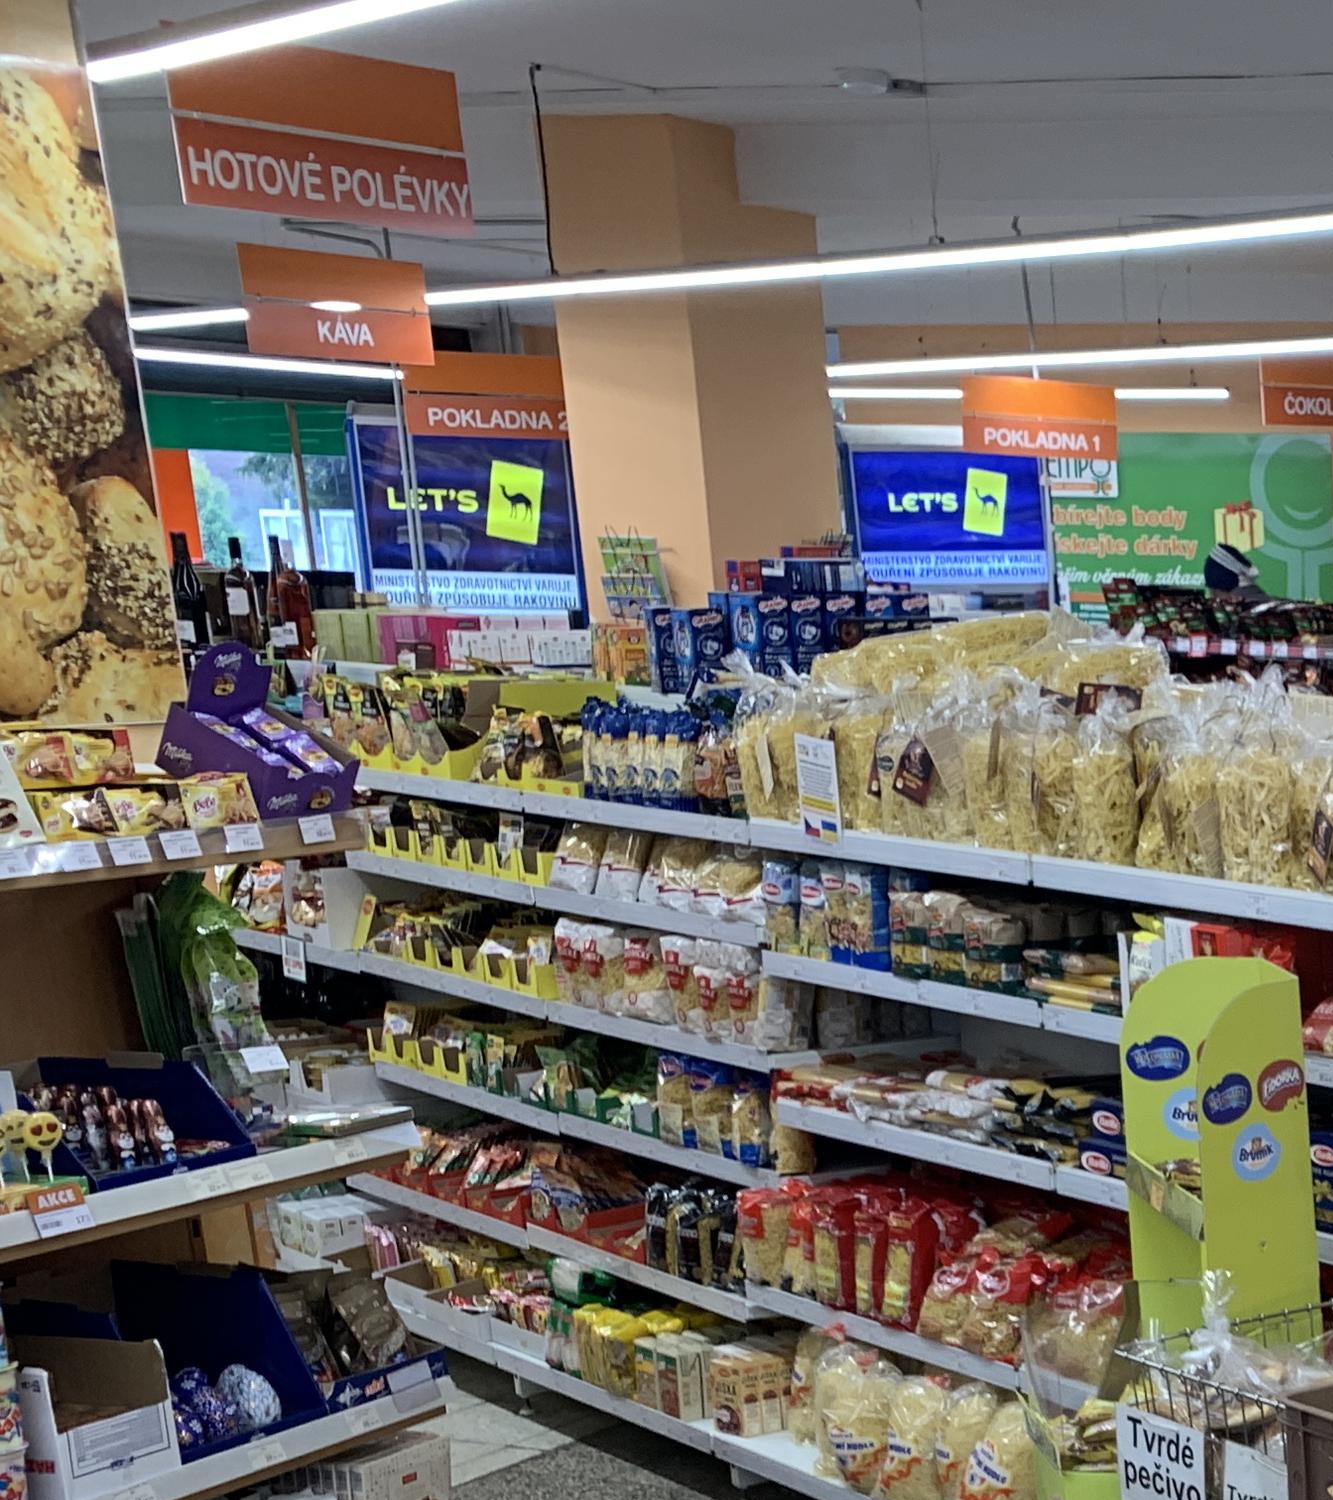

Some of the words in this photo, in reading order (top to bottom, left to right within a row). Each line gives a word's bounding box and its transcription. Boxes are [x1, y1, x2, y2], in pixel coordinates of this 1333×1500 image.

[187, 145, 323, 202] HOTOVÉ
[332, 166, 470, 218] POLÉVKY
[317, 315, 374, 347] KÁVA
[427, 406, 553, 431] POKLADNA
[984, 427, 1087, 450] POKLADNA
[1092, 436, 1100, 451] 1
[386, 486, 479, 513] LET'S
[887, 492, 958, 513] LET'S
[1055, 508, 1127, 530] bírejte
[1132, 505, 1187, 529] body
[1055, 535, 1128, 558] ískejte
[1134, 538, 1197, 558] dárky
[1155, 566, 1205, 583] zákaz
[1172, 1108, 1198, 1122] Bru
[37, 1188, 77, 1209] AKCE
[1127, 1416, 1195, 1469] Tvrdé
